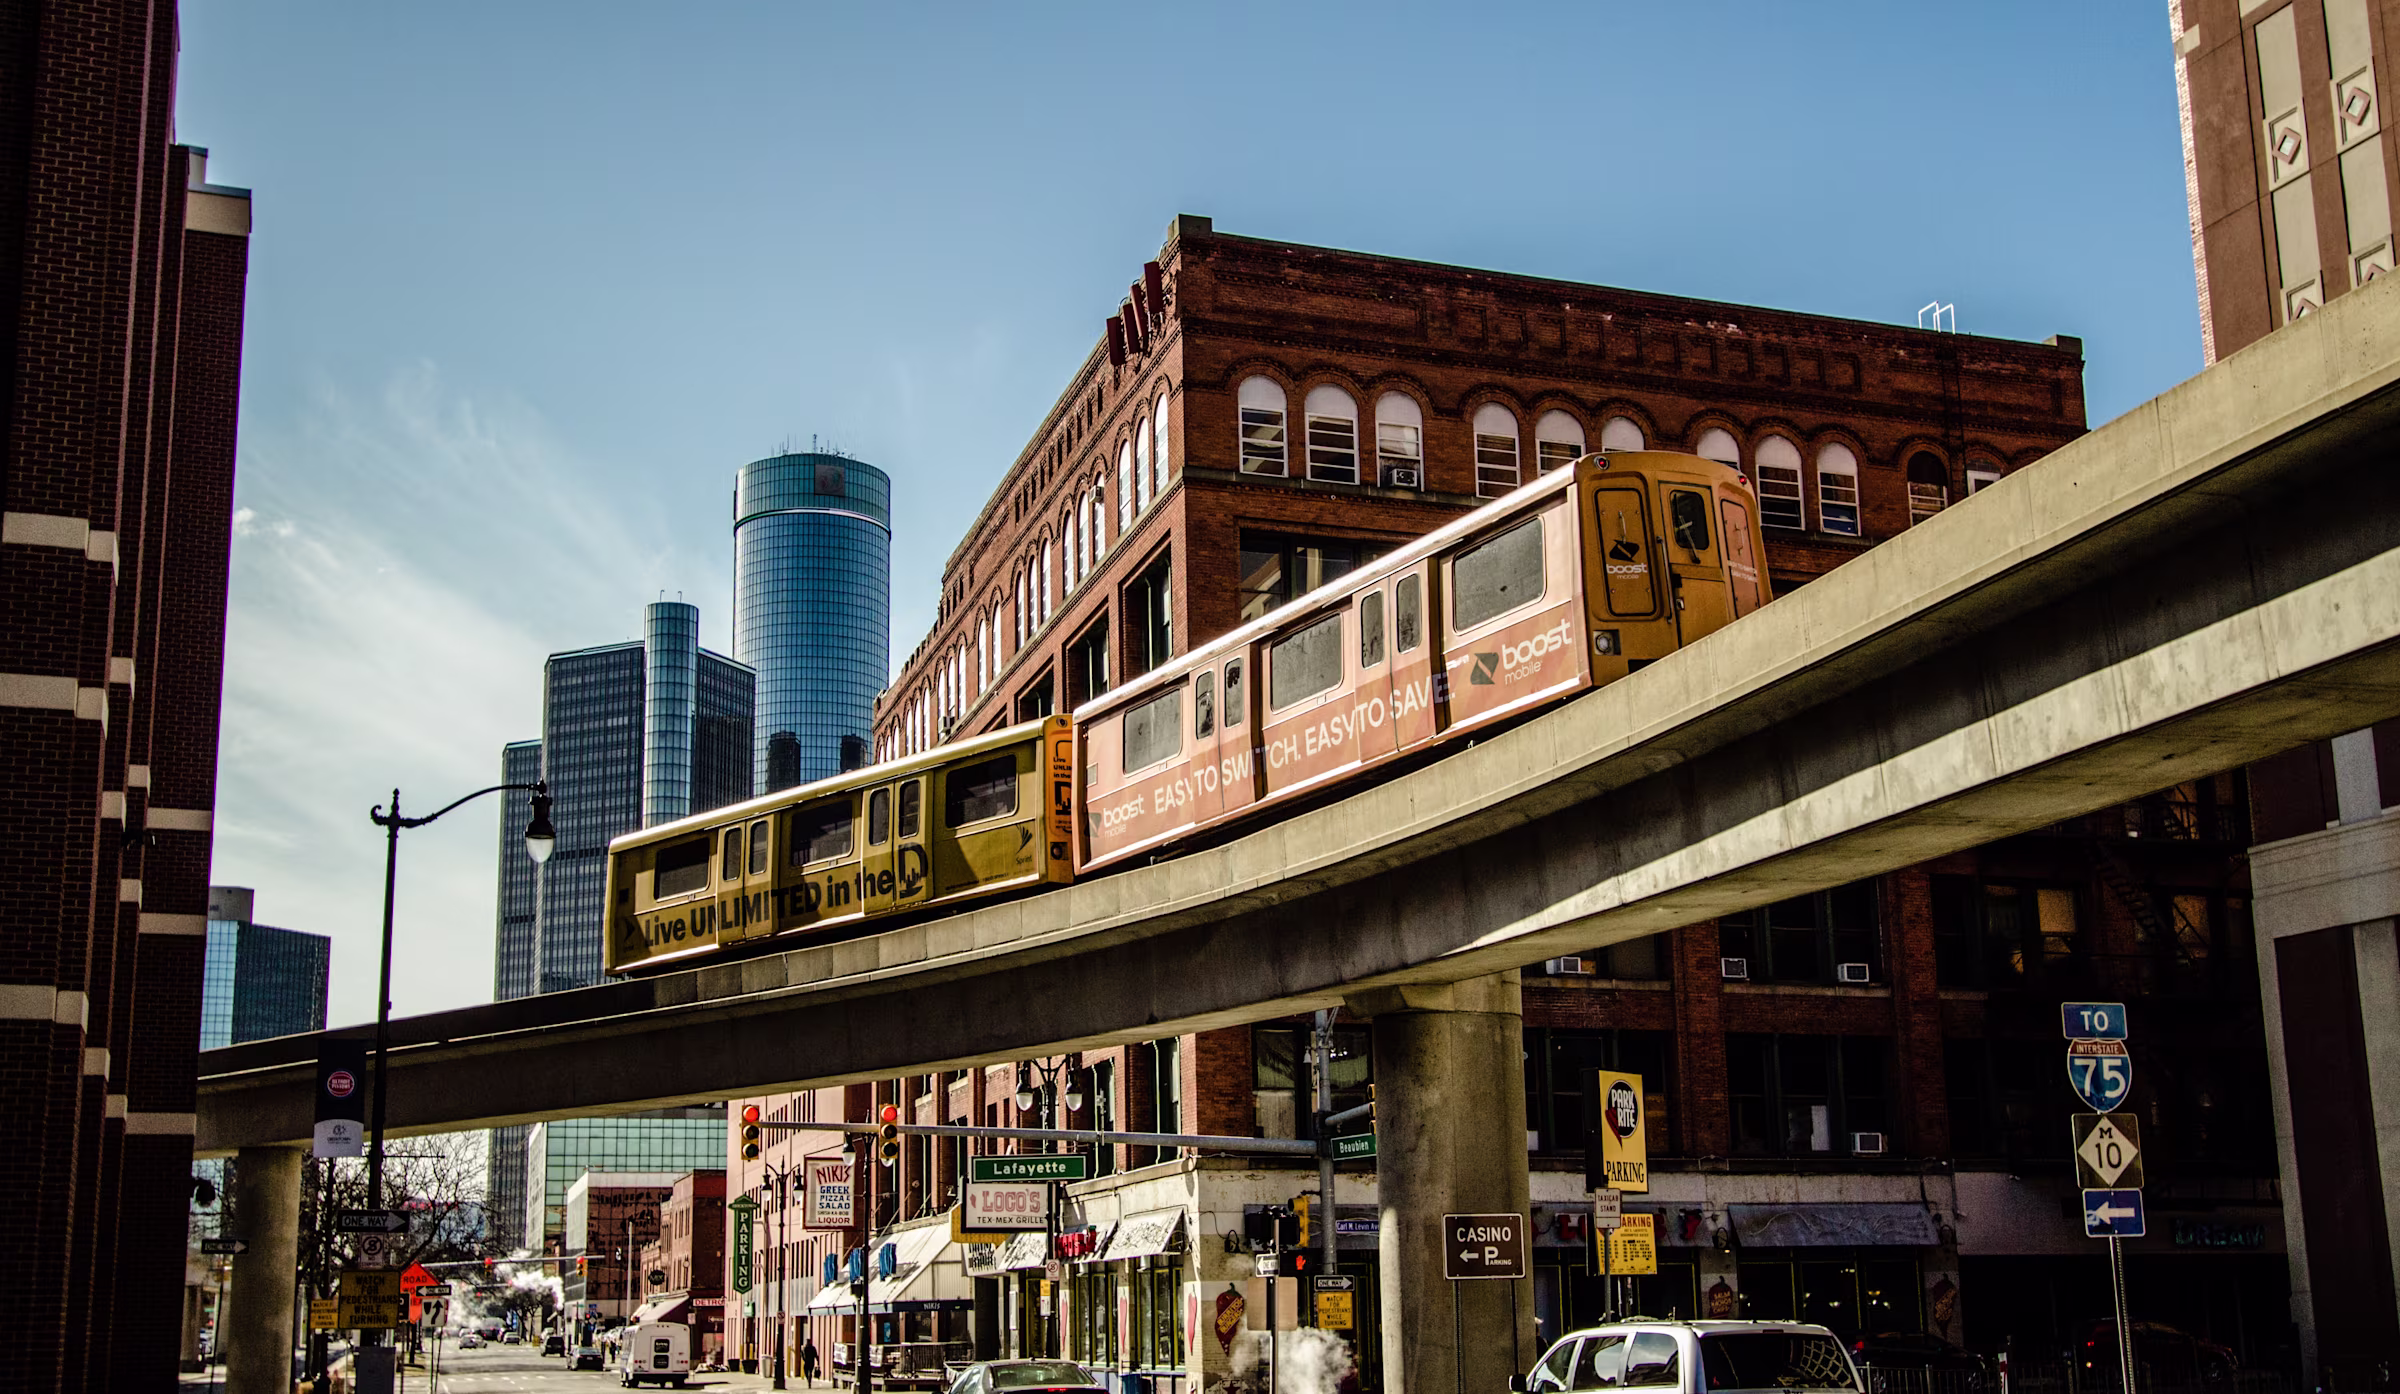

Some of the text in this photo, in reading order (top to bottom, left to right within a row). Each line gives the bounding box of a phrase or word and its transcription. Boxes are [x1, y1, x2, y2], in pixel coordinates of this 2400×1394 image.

[1606, 562, 1648, 574] boost
[1502, 618, 1572, 670] boost
[1504, 661, 1542, 685] mobile
[1154, 777, 1194, 815] EASY
[1194, 765, 1218, 796] TO
[1305, 709, 1356, 756] EASY
[1355, 697, 1385, 733] TO
[1103, 794, 1145, 828] boost
[1104, 823, 1127, 838] mobile
[644, 914, 686, 948] Live
[690, 880, 822, 938] UNLIMITED
[827, 875, 850, 908] in
[855, 867, 893, 902] the
[2080, 1011, 2109, 1031] TO
[2076, 1044, 2120, 1054] INTERSTATE
[2074, 1058, 2126, 1098] 75
[1611, 1088, 1635, 1109] PARK
[1617, 1108, 1636, 1128] RITE
[2099, 1127, 2113, 1139] M
[1339, 1140, 1370, 1153] Beaubien
[2095, 1142, 2122, 1169] 10
[993, 1162, 1066, 1176] Lafayette
[1606, 1160, 1645, 1183] PARKING
[820, 1185, 850, 1194] GREEK
[982, 1188, 1041, 1213] LOCO'S
[344, 1216, 387, 1226] ONE WAY
[977, 1216, 1044, 1224] TEX-MEX GRILLE
[1337, 1222, 1348, 1231] Carl
[1355, 1222, 1369, 1230] Levin
[1621, 1216, 1652, 1228] ARKING
[1457, 1226, 1512, 1242] CASINO
[738, 1212, 749, 1287] PARKING
[356, 1276, 385, 1285] WATCH
[362, 1285, 379, 1294] FOR
[341, 1295, 398, 1304] PEDESTRIANS
[354, 1304, 381, 1314] WHILE
[350, 1315, 388, 1324] TURNING
